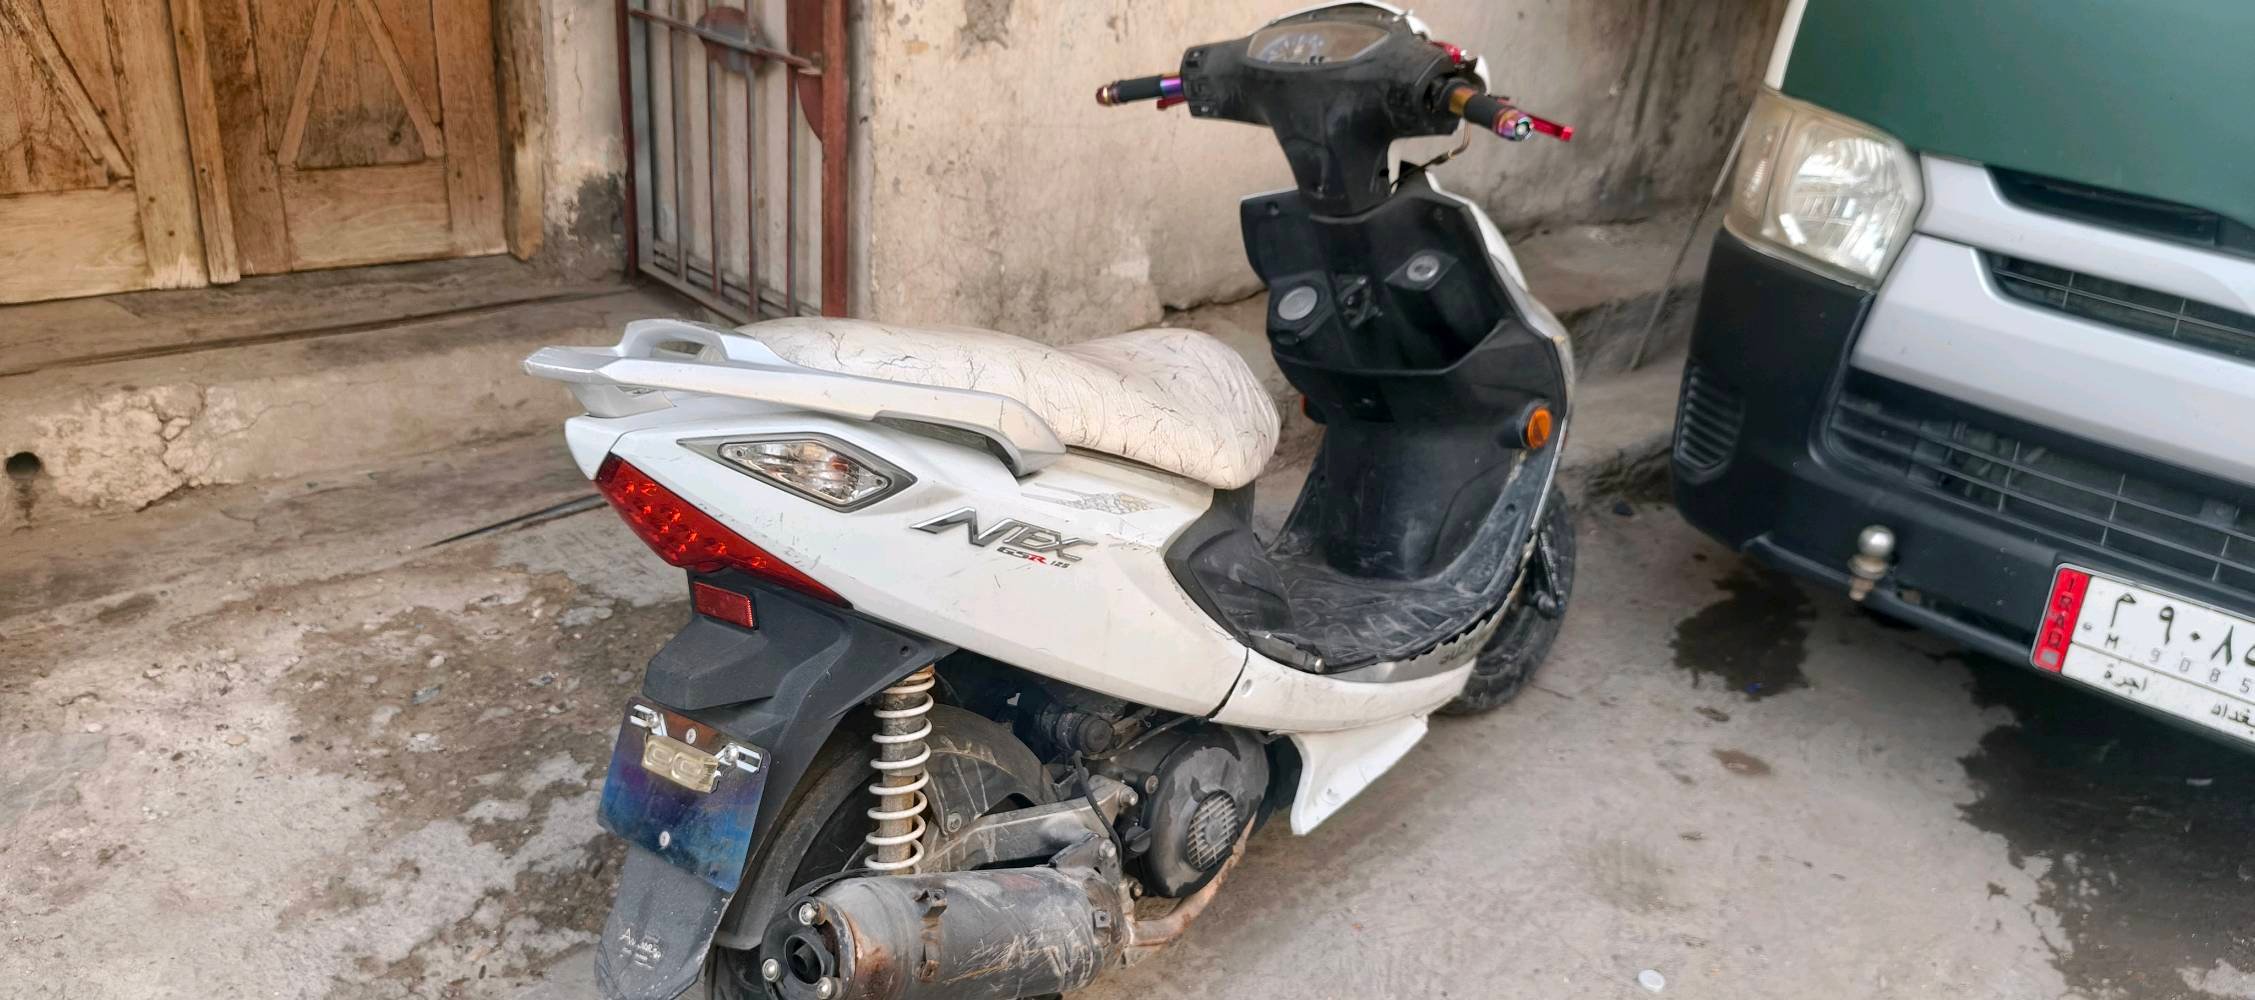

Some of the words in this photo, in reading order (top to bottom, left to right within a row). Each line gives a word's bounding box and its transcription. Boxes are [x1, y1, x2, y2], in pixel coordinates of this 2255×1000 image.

[997, 546, 1047, 565] GSR
[1050, 560, 1071, 569] 125
[2048, 577, 2075, 651] IRAQ
